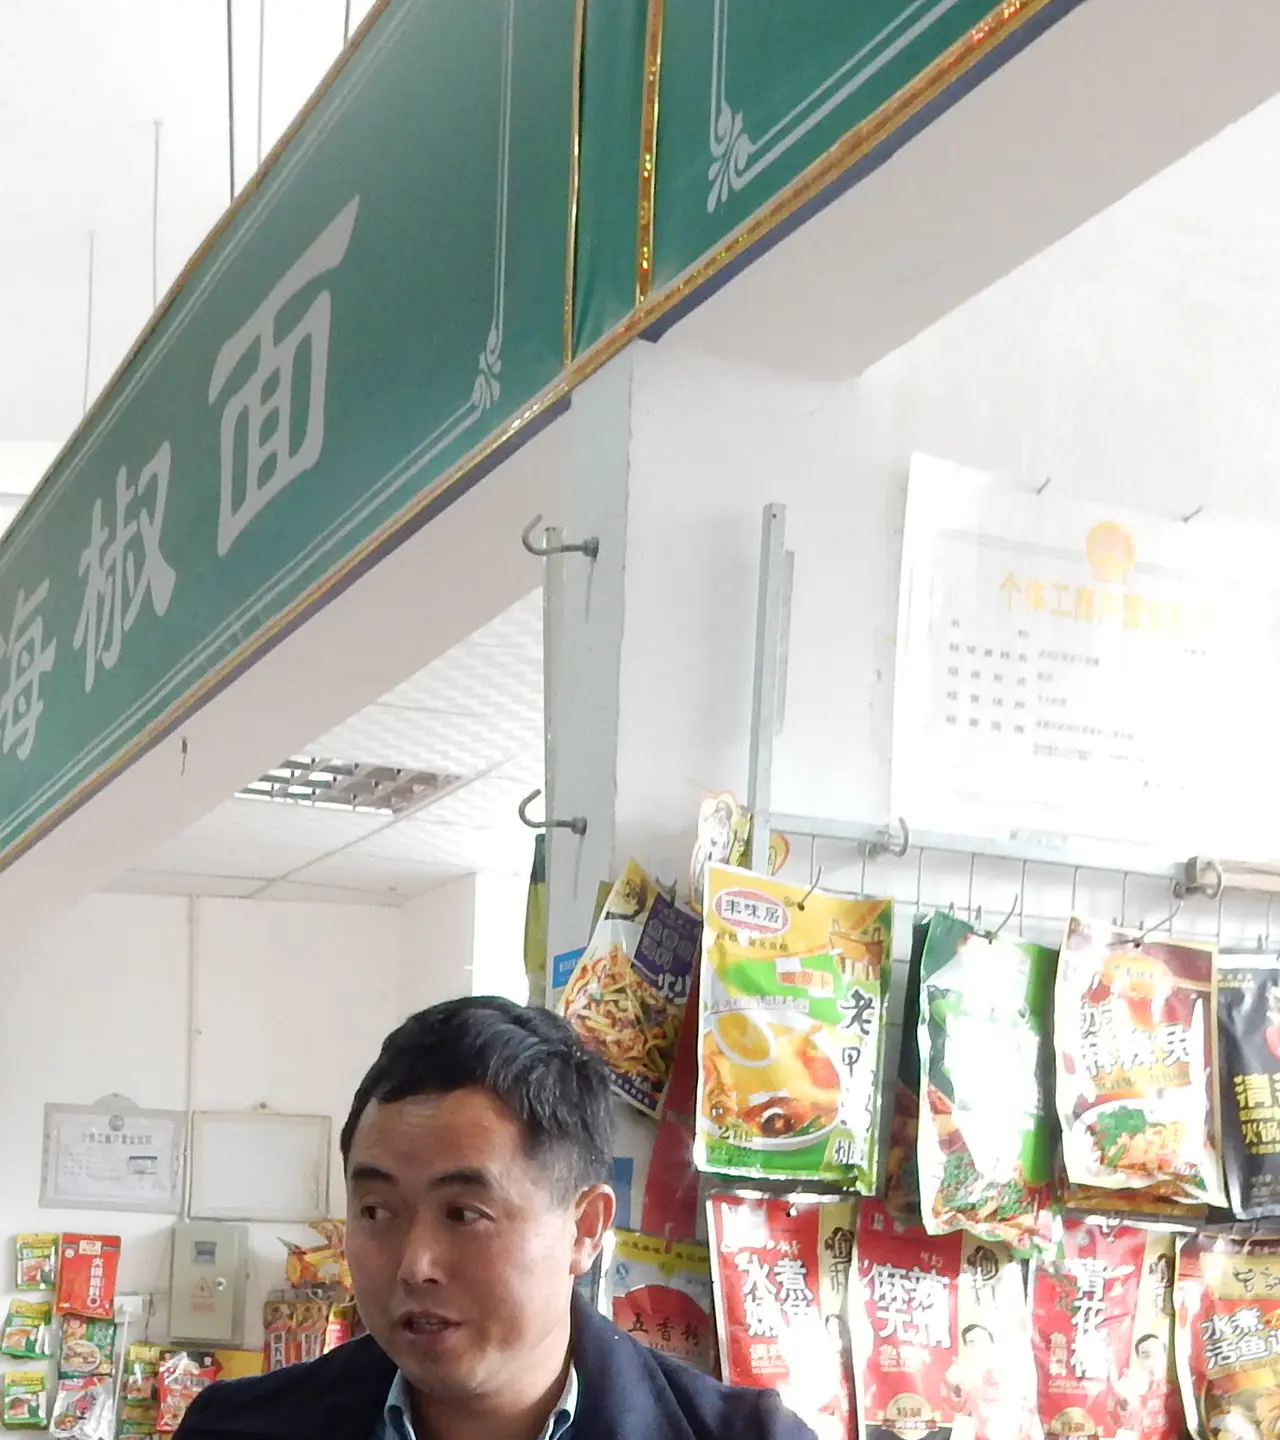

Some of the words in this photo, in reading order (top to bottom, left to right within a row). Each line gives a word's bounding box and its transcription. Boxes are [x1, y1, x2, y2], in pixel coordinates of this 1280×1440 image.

[628, 1312, 700, 1347] 五香粉
[1201, 1307, 1265, 1340] 水煮
